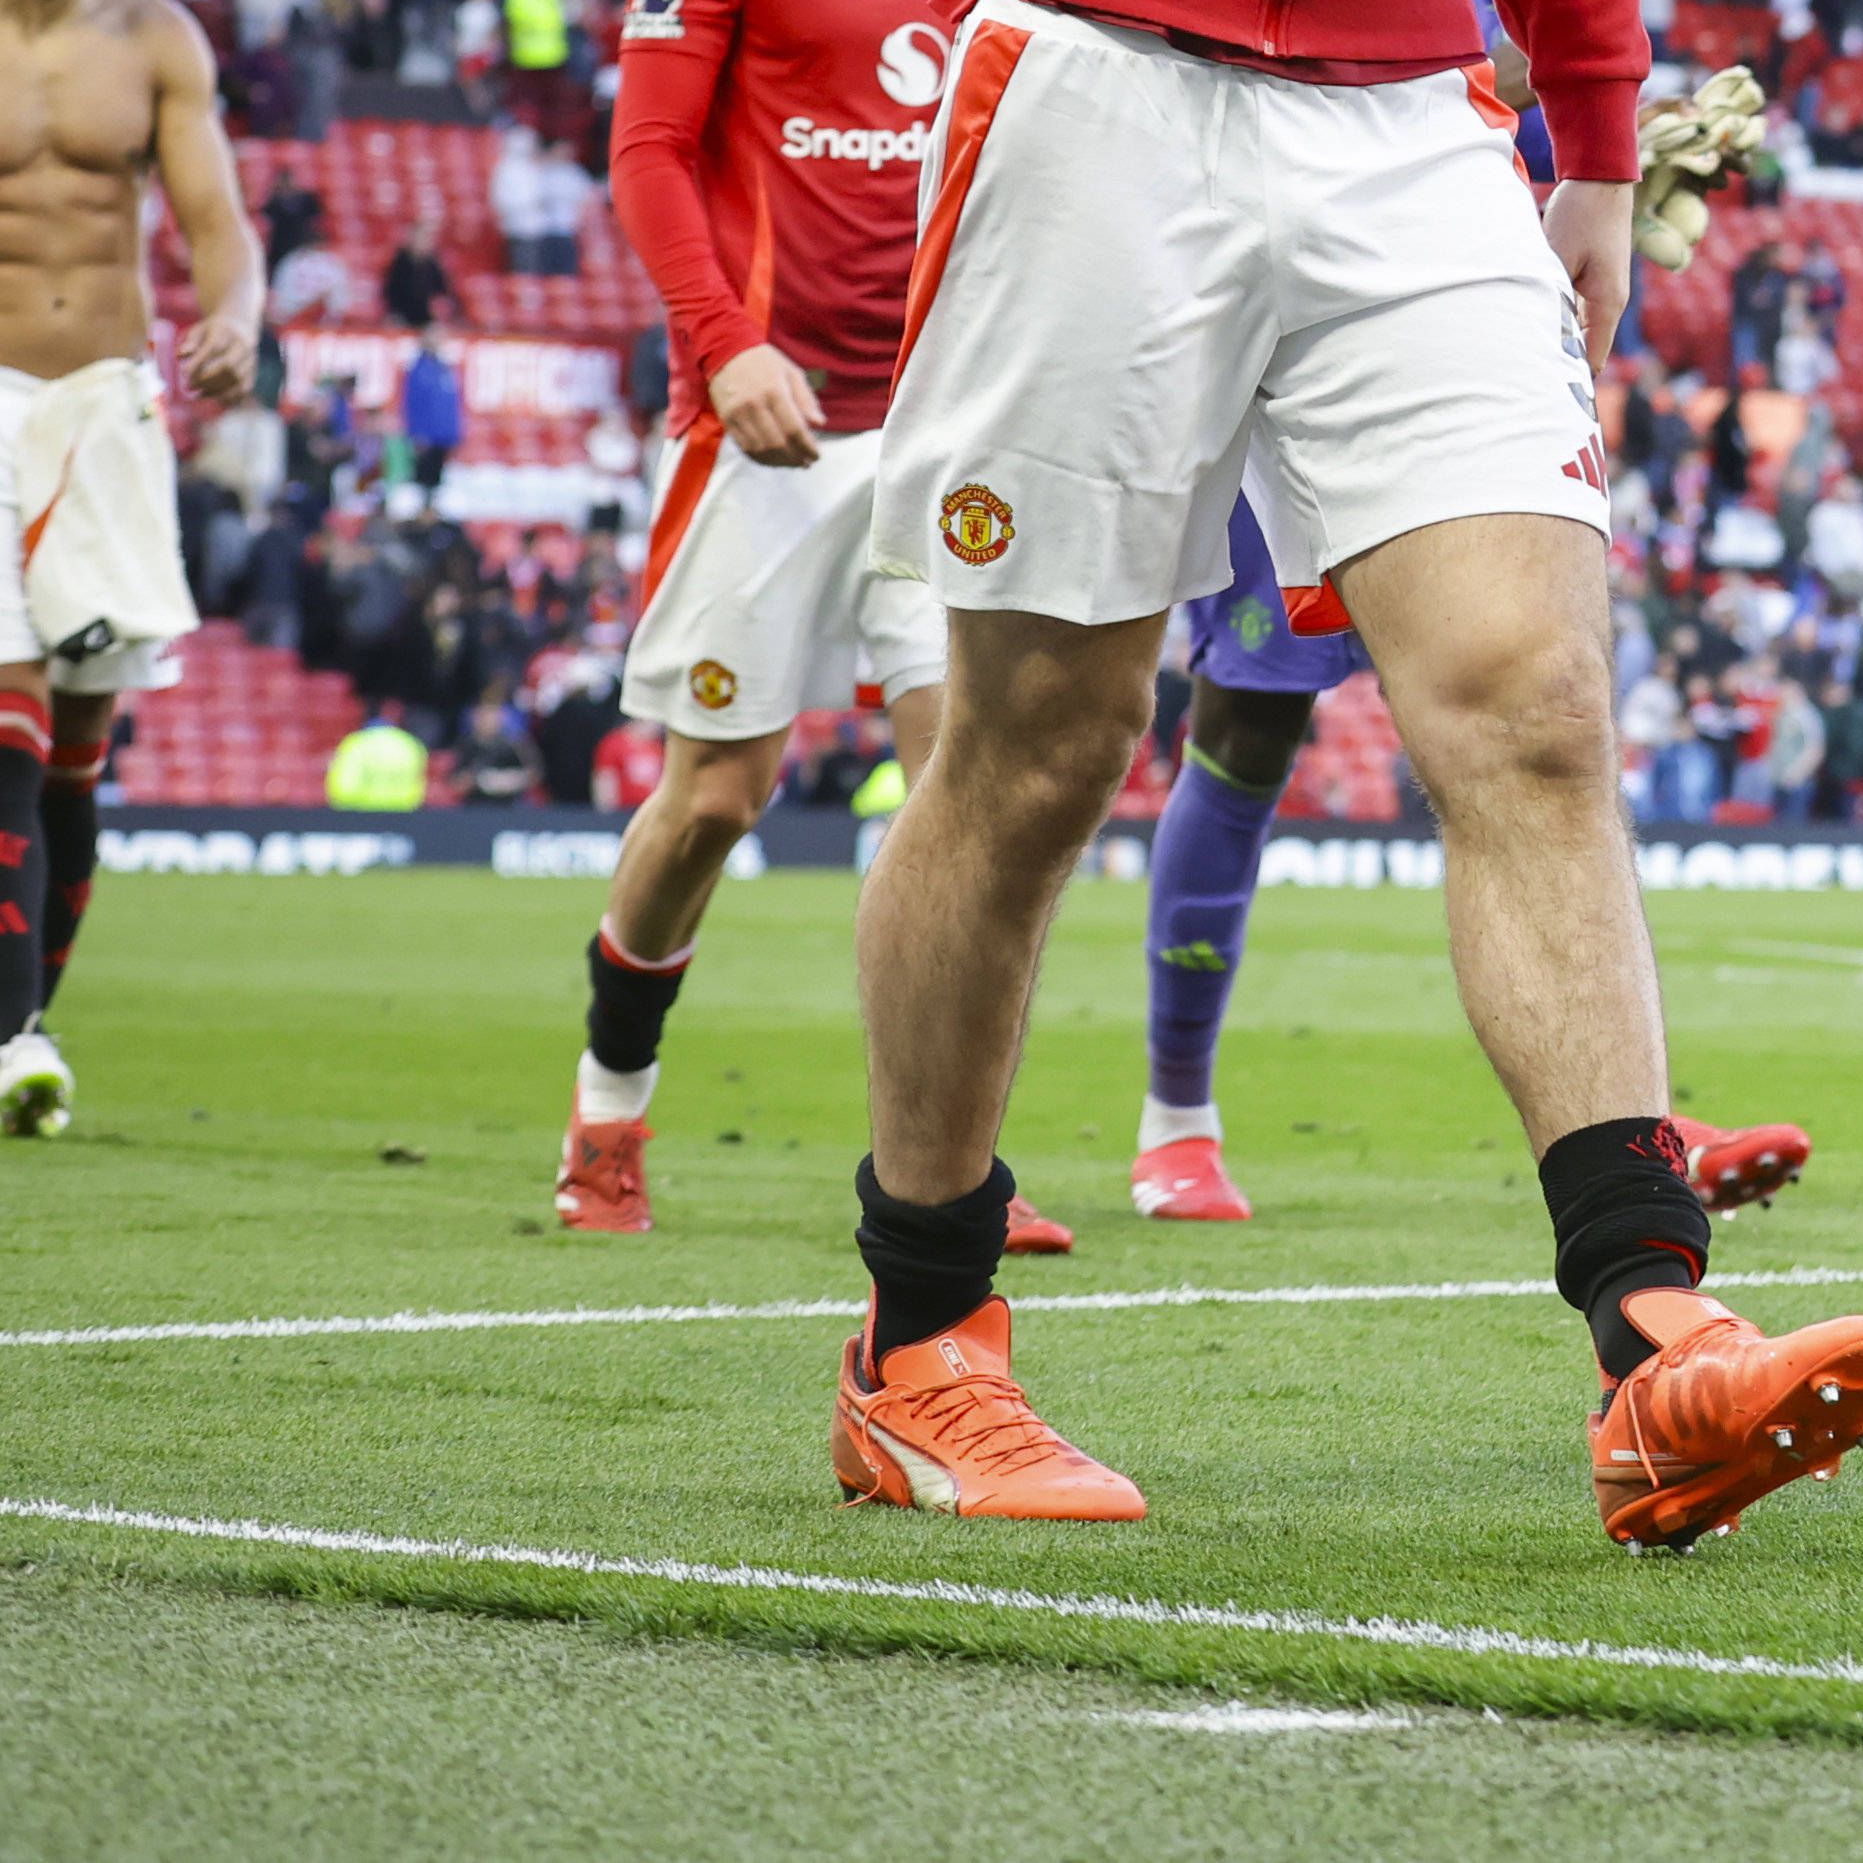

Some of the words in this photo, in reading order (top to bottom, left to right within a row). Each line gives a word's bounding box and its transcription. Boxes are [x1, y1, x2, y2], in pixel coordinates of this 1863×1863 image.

[780, 116, 927, 171] Snapd
[946, 489, 1007, 519] MANCHESTER
[954, 543, 997, 560] UNITED
